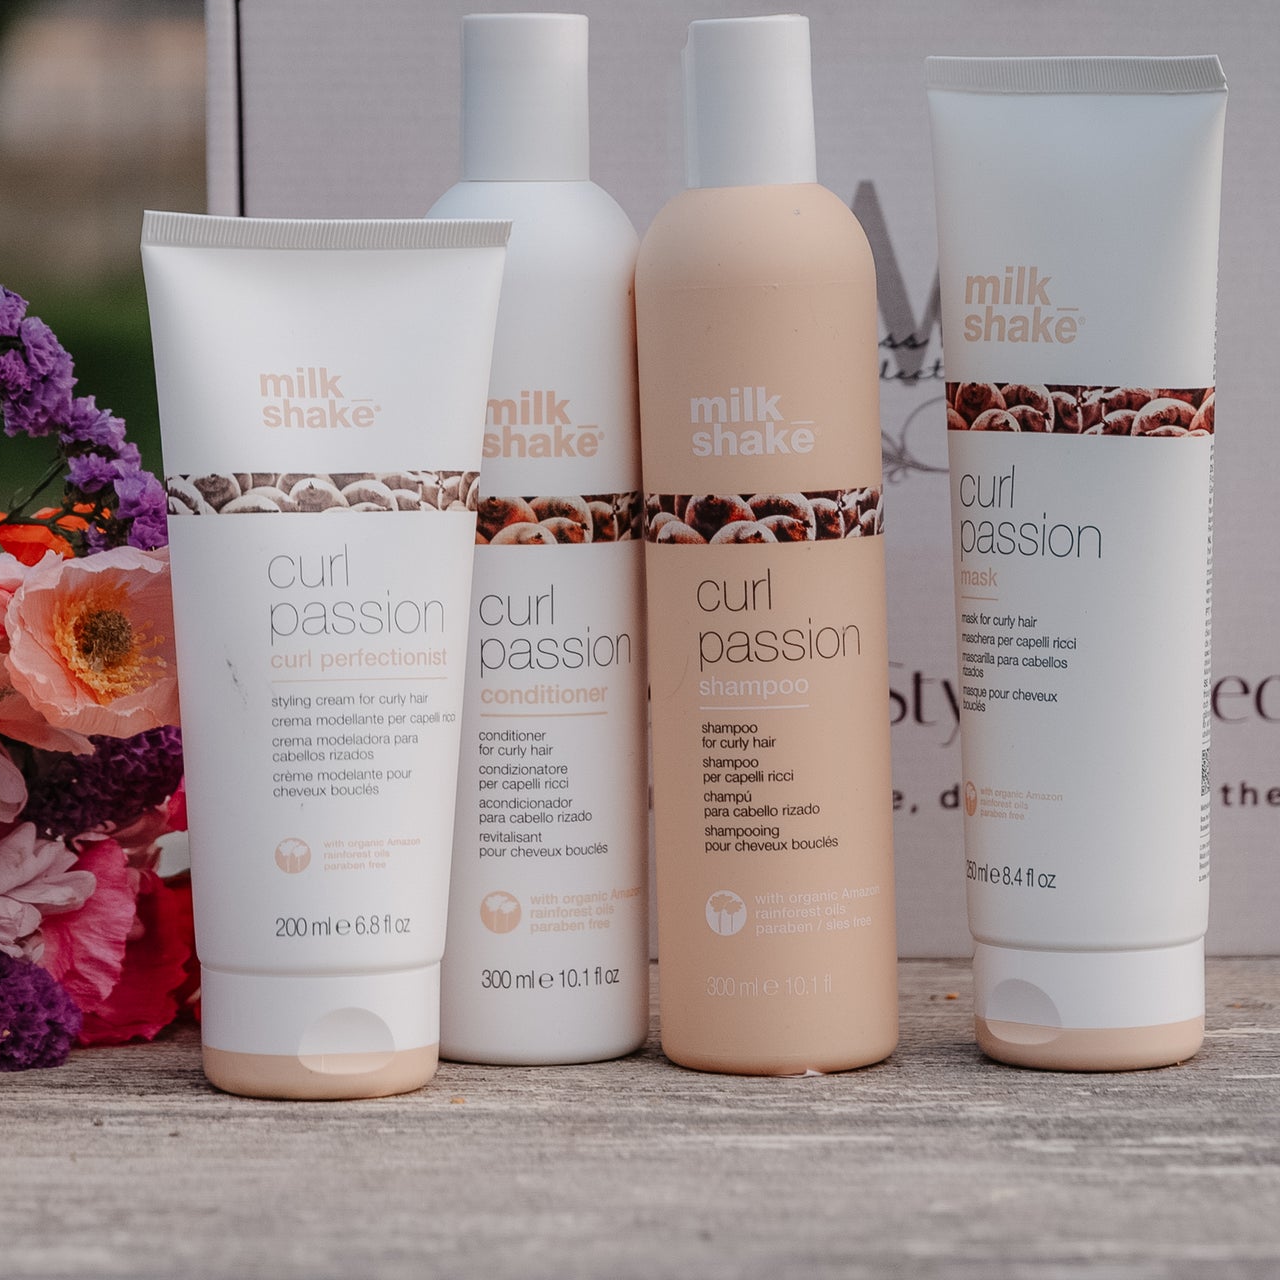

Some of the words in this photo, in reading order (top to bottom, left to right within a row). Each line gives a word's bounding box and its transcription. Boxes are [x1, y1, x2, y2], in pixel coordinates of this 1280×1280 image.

[964, 266, 1052, 305] milk
[259, 368, 344, 399] milk
[485, 390, 571, 425] milk
[690, 387, 784, 423] milk
[959, 465, 1016, 508] curl
[960, 512, 1102, 561] passion
[268, 544, 349, 589] curl
[960, 568, 998, 588] mask
[697, 568, 771, 611] curl
[479, 584, 554, 626] curl
[271, 590, 445, 646] passion
[962, 613, 978, 624] mask
[980, 613, 991, 625] for
[993, 615, 1015, 629] curly
[1018, 616, 1037, 627] hair
[699, 618, 860, 672] passion
[962, 632, 995, 645] maschera
[998, 637, 1013, 648] per
[1016, 636, 1050, 649] capelli
[1053, 637, 1077, 649] ricci
[271, 650, 311, 669] curl
[321, 647, 447, 672] perfectionist
[480, 626, 631, 678] passion
[997, 656, 1019, 667] para
[1022, 656, 1068, 668] cabellos
[480, 685, 608, 704] conditioner
[699, 677, 809, 700] shampoo
[963, 686, 986, 699] masque
[989, 689, 1010, 700] pour
[1012, 689, 1058, 702] cheveux
[271, 695, 311, 709] styling
[316, 695, 355, 705] cream
[359, 694, 375, 704] for
[379, 693, 406, 707] curly
[409, 692, 428, 704] hair
[272, 716, 312, 727] crema
[316, 714, 384, 726] modellante
[388, 714, 406, 727] per
[409, 712, 440, 725] capelli
[479, 730, 546, 742] conditioner
[702, 722, 758, 736] shampoo
[272, 736, 312, 747] crema
[317, 734, 390, 746] modeladora
[394, 733, 418, 746] para
[702, 738, 716, 749] for
[720, 737, 749, 751] curly
[753, 737, 776, 748] hair
[272, 750, 325, 762] cabellos
[329, 749, 374, 761] rizados
[479, 744, 493, 756] for
[498, 745, 526, 758] curly
[531, 744, 553, 756] hair
[479, 764, 568, 775] condizionatore
[702, 757, 759, 771] shampoo
[273, 770, 313, 782] crème
[317, 769, 382, 781] modelante
[386, 769, 412, 781] pour
[703, 772, 721, 785] per
[725, 771, 764, 785] capelli
[768, 771, 794, 782] ricci
[273, 784, 326, 797] cheveux
[330, 784, 379, 796] bouclés
[479, 780, 497, 792] per
[501, 778, 540, 792] capelli
[544, 778, 569, 789] ricci
[479, 798, 572, 809] acondicionador
[703, 791, 752, 805] champú
[1026, 790, 1063, 801] Amazon
[479, 813, 506, 825] para
[509, 812, 553, 824] cabello
[557, 811, 592, 823] rizado
[704, 806, 730, 819] para
[733, 805, 778, 817] cabello
[782, 804, 820, 816] rizado
[479, 831, 542, 843] revitalisant
[704, 825, 780, 839] shampooing
[323, 840, 344, 848] with
[348, 840, 384, 849] organic
[387, 837, 421, 846] Amazon
[479, 846, 506, 859] pour
[510, 846, 562, 858] cheveux
[565, 843, 608, 857] bouclés
[704, 841, 731, 853] pour
[735, 839, 788, 851] cheveux
[792, 836, 839, 850] bouclés
[324, 850, 371, 859] rainforest
[374, 849, 390, 857] oils
[369, 861, 386, 869] free
[978, 864, 988, 882] ml
[1003, 866, 1022, 886] 8.4
[1026, 868, 1034, 887] fl
[1038, 873, 1056, 889] oz
[530, 893, 558, 904] with
[563, 891, 608, 906] organic
[755, 893, 784, 904] with
[789, 890, 838, 905] organic
[842, 886, 880, 899] Amazon
[530, 907, 592, 919] rainforest
[596, 903, 615, 915] oils
[756, 906, 821, 920] rainforest
[825, 903, 846, 916] oils
[276, 917, 308, 937] 200
[312, 917, 331, 936] ml
[356, 915, 379, 934] 6.8
[384, 915, 391, 934] fl
[395, 918, 410, 933] oz
[530, 920, 585, 934] paraben
[589, 919, 610, 929] free
[756, 922, 812, 936] paraben
[826, 919, 850, 930] sles
[853, 915, 872, 928] free
[481, 969, 511, 989] 300
[516, 970, 534, 988] ml
[559, 968, 588, 988] 10.1
[595, 967, 602, 985] fl
[605, 968, 619, 983] oz
[706, 976, 735, 996] 300
[739, 977, 758, 997] ml
[786, 975, 817, 996] 10.1
